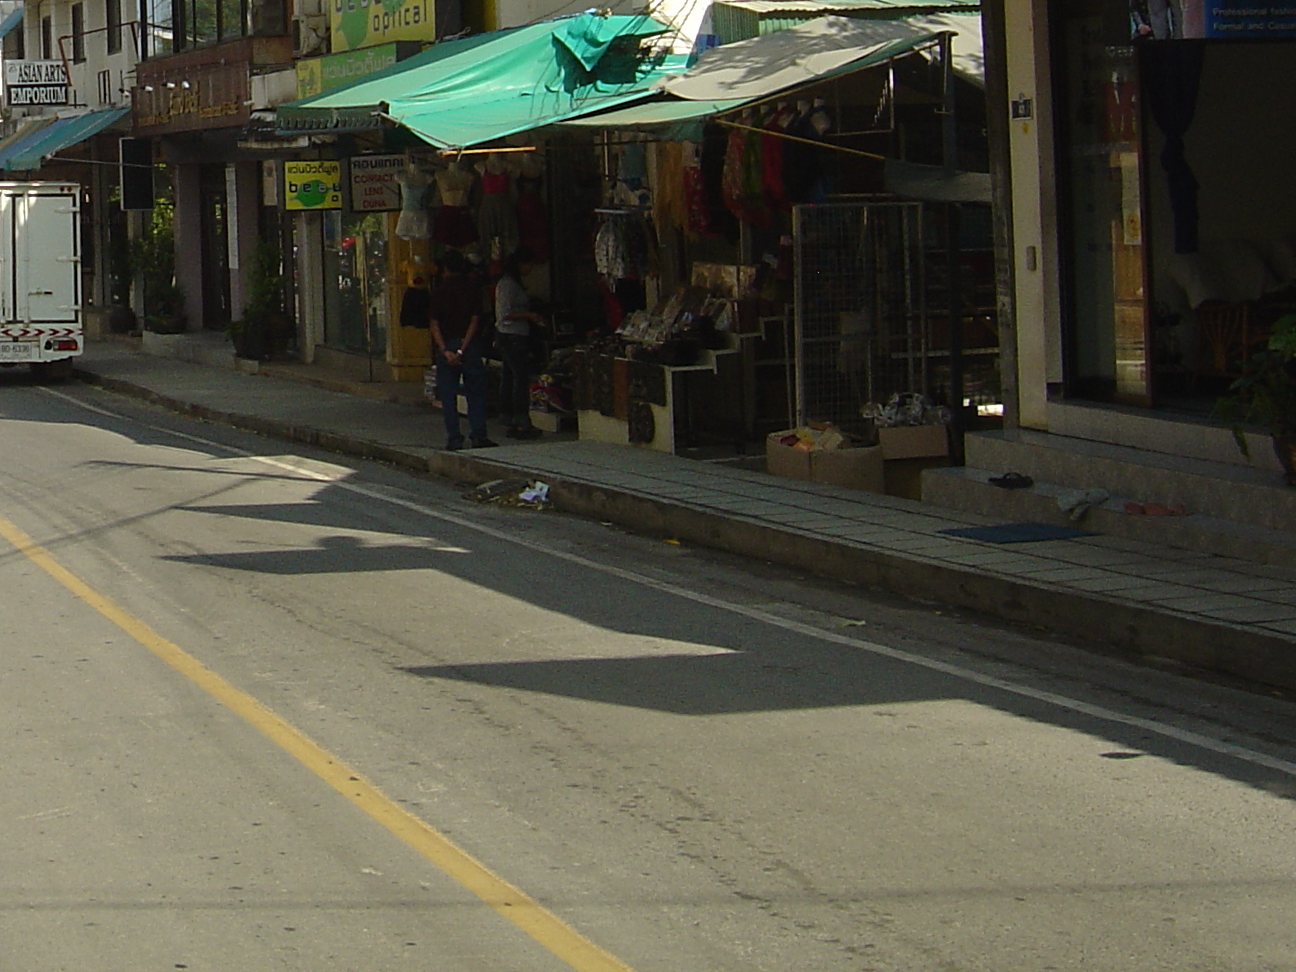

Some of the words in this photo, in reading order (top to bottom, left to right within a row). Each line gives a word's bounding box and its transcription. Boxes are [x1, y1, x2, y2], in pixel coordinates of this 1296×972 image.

[17, 64, 43, 83] ASIAN
[44, 64, 66, 82] ARTS
[10, 87, 66, 104] EMPORIUM
[364, 187, 384, 196] LENS
